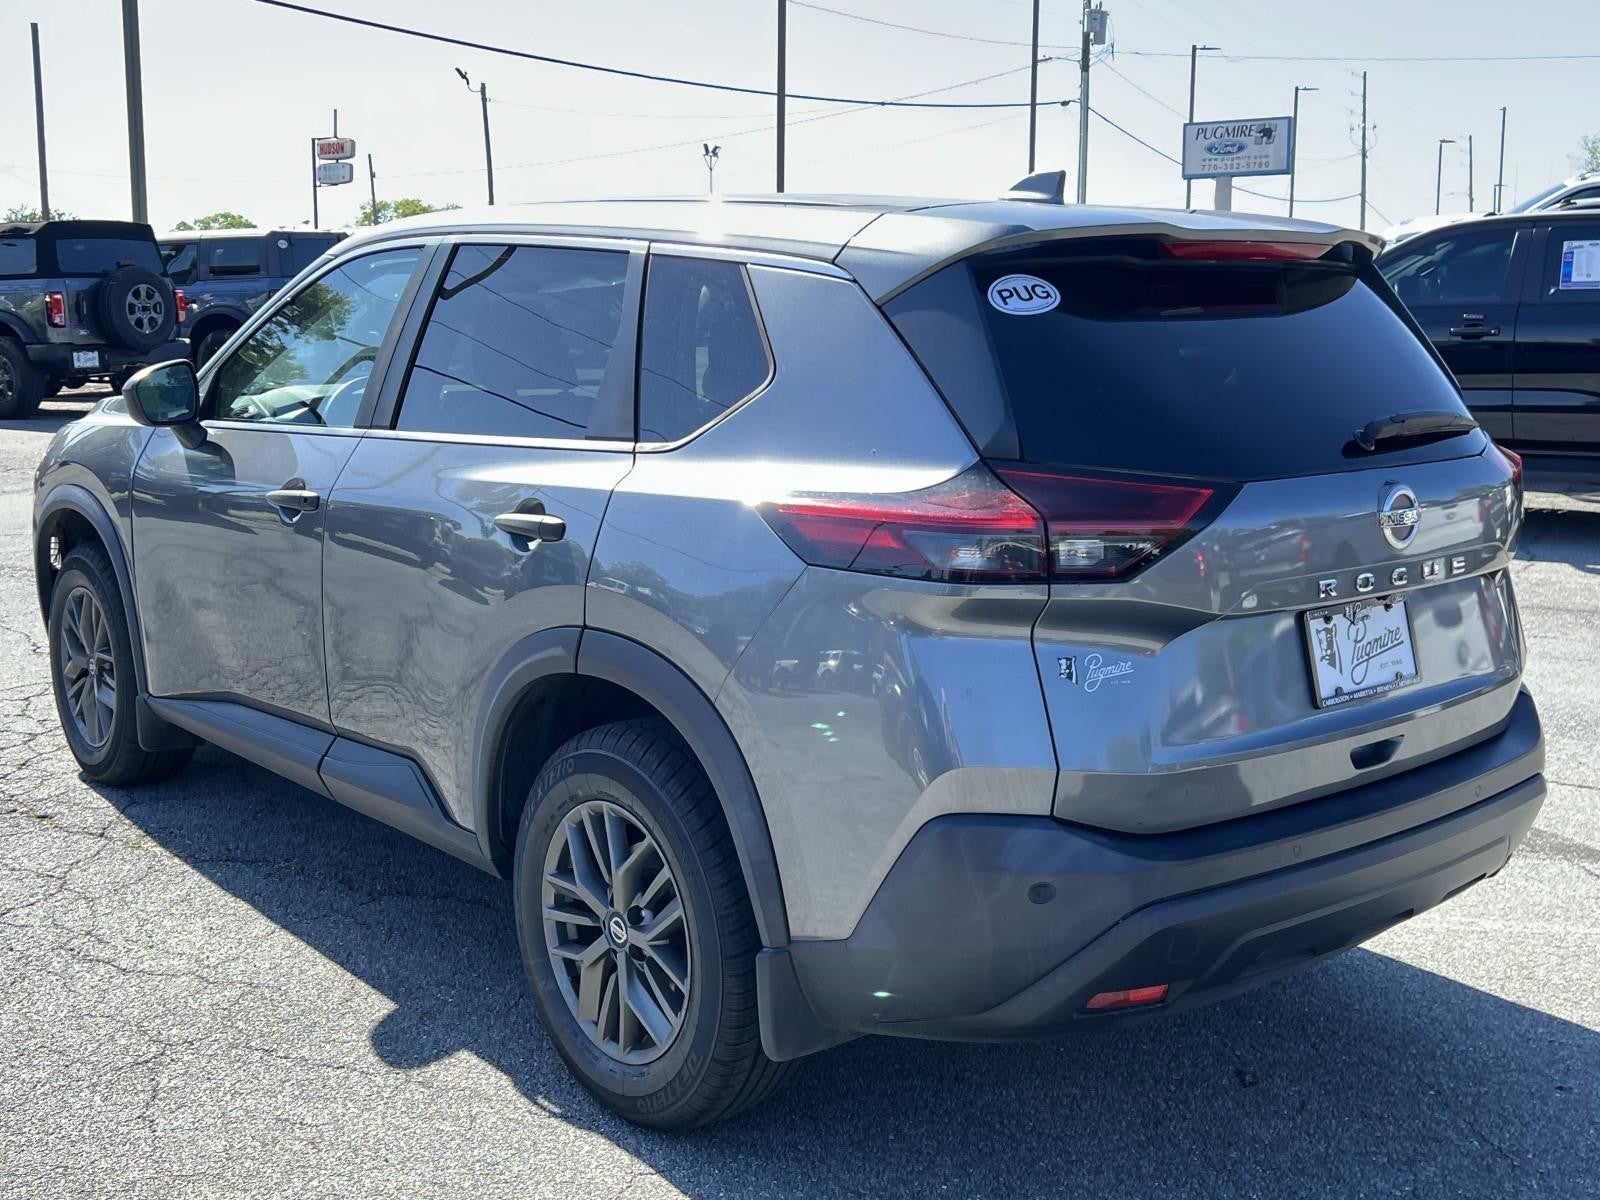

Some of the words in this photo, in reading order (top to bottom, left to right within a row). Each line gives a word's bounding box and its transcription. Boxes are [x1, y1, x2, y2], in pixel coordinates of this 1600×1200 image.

[1196, 124, 1256, 140] PUGMIRE
[1212, 141, 1239, 153] Ford
[996, 284, 1053, 306] PUG
[1319, 556, 1466, 598] ROGUE
[1347, 618, 1404, 686] Pugmire
[1085, 653, 1134, 692] Pugmire
